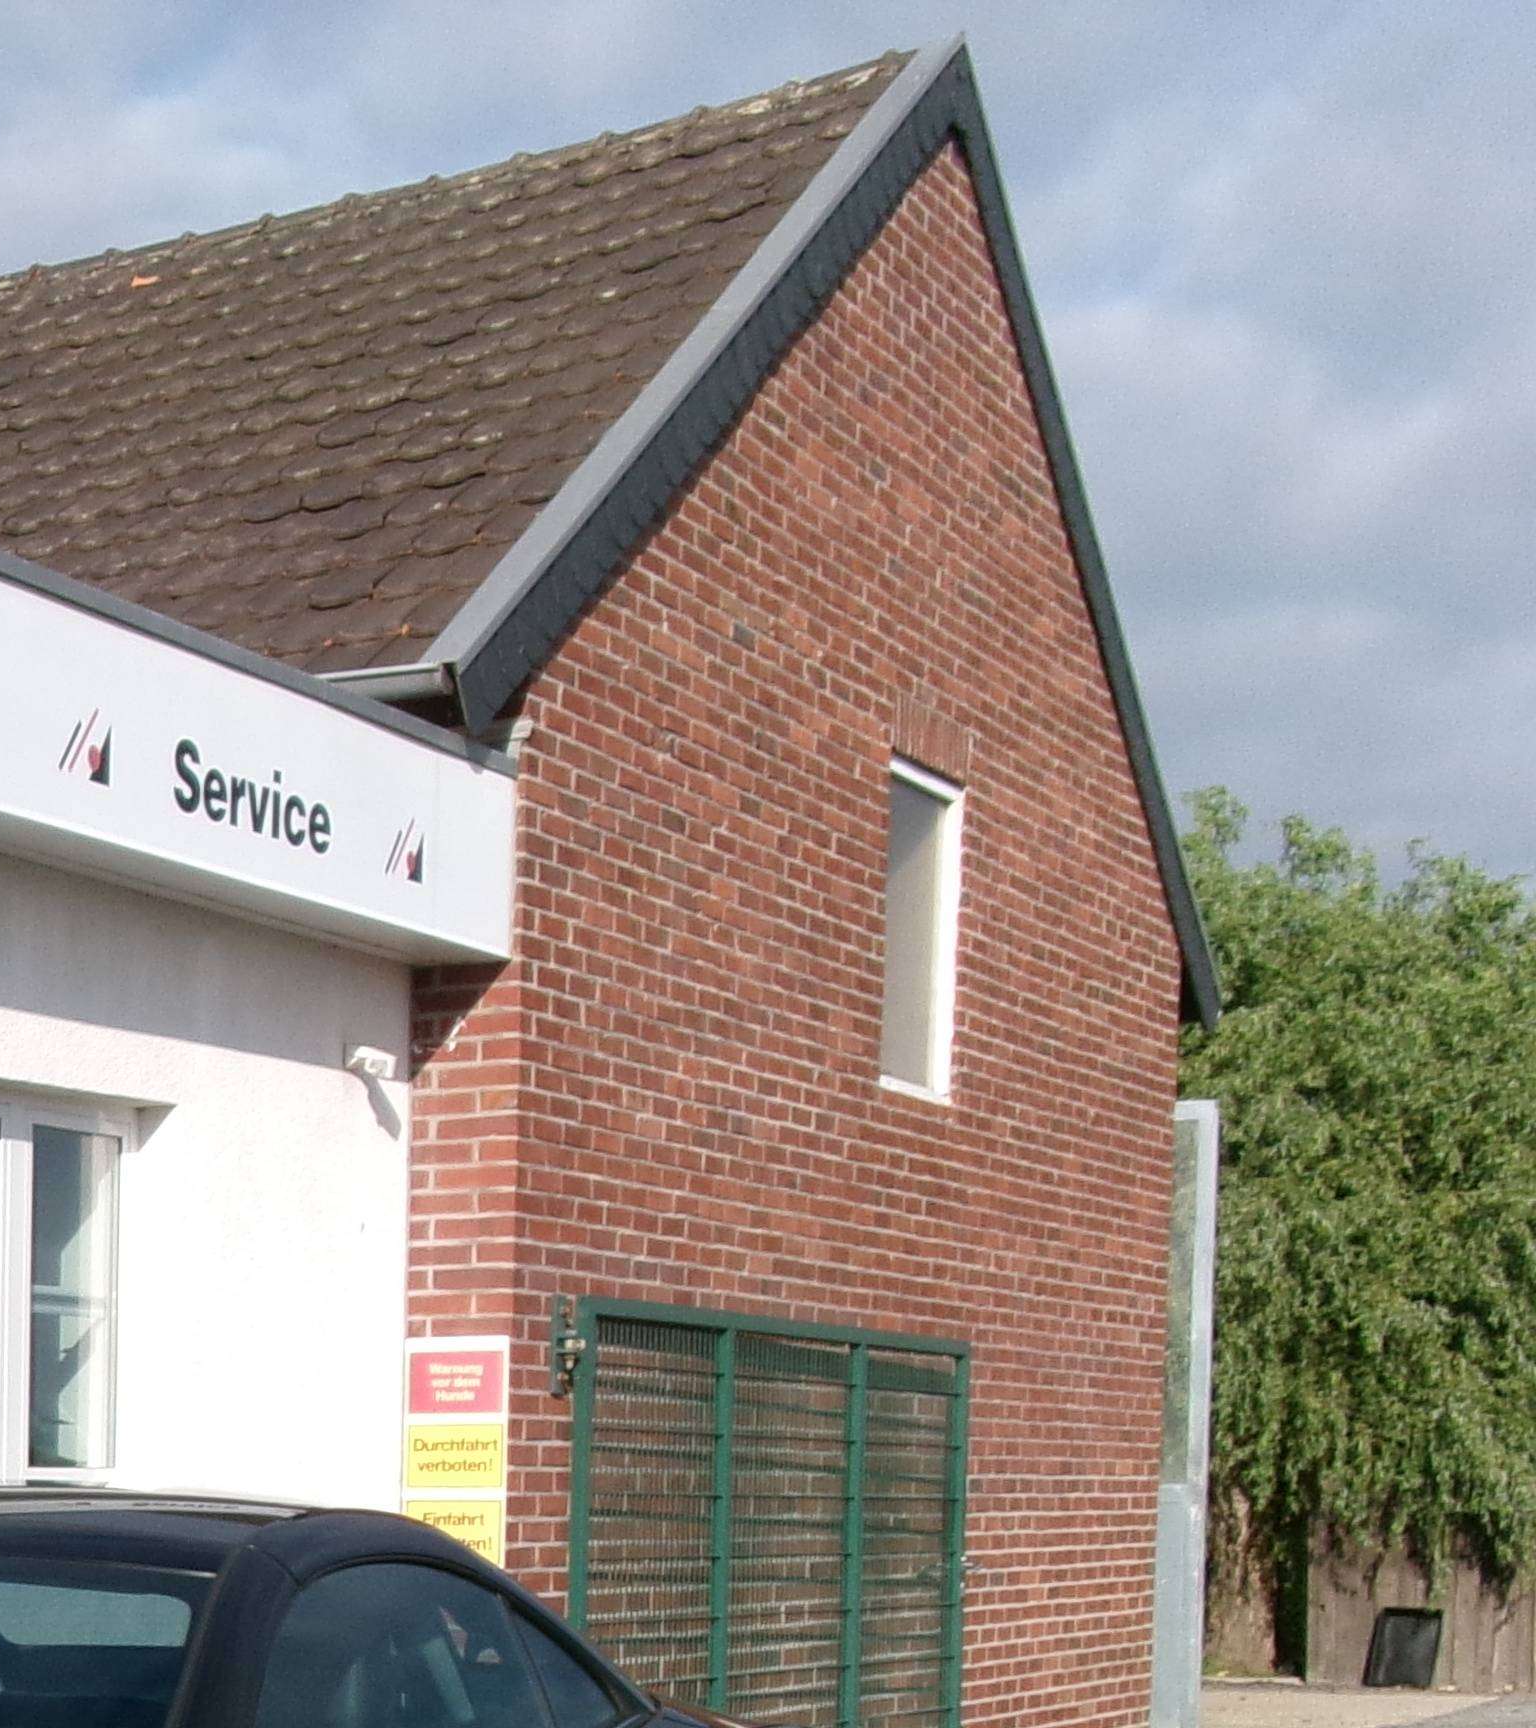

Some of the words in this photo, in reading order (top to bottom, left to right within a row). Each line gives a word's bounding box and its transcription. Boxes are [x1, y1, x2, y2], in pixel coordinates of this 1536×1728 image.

[173, 737, 332, 855] Service
[412, 1437, 498, 1452] Durchfahrt
[417, 1458, 493, 1473] verboten!
[422, 1512, 485, 1528] Einfahrt
